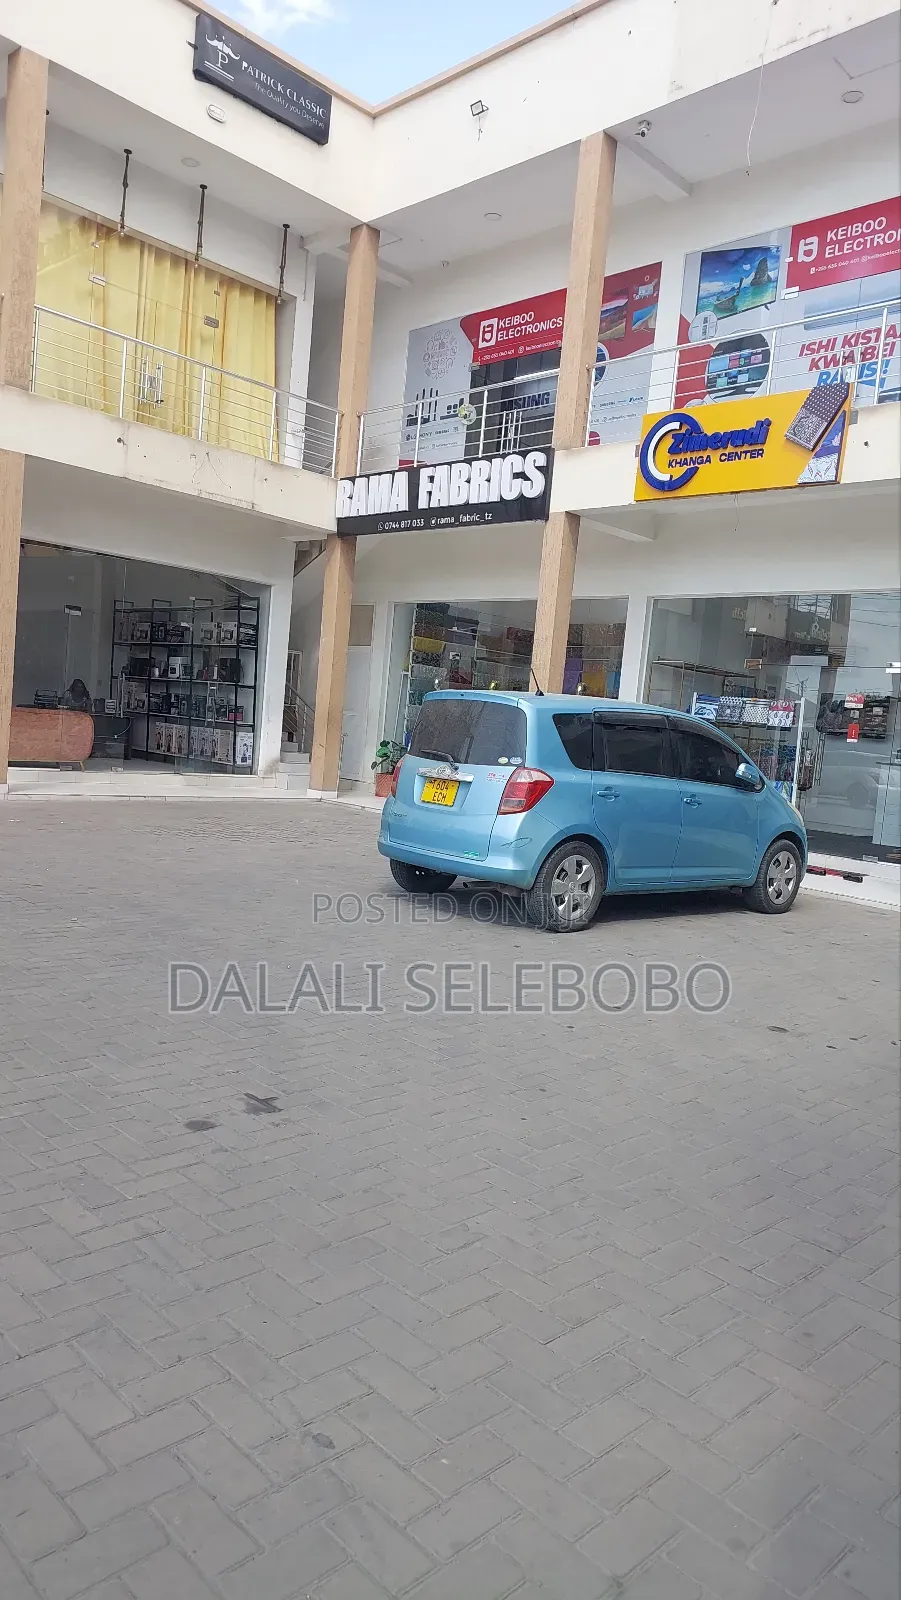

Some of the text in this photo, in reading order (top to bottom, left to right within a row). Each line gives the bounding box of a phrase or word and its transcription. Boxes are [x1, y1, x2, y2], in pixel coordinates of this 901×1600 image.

[241, 60, 327, 119] PATRICK CLASSIC
[289, 104, 301, 116] you
[827, 216, 887, 243] KEIBOO
[497, 316, 563, 341] ELECTRONICS
[498, 311, 535, 329] KEIBOO
[798, 323, 901, 357] ISHI KISTA
[808, 349, 856, 371] KWA
[667, 417, 772, 455] Zimerudi
[667, 448, 764, 468] KHANGA CENTER
[335, 451, 547, 518] RAMA FABRICS
[384, 521, 400, 530] 0744
[400, 520, 411, 529] 817
[412, 518, 424, 527] 033
